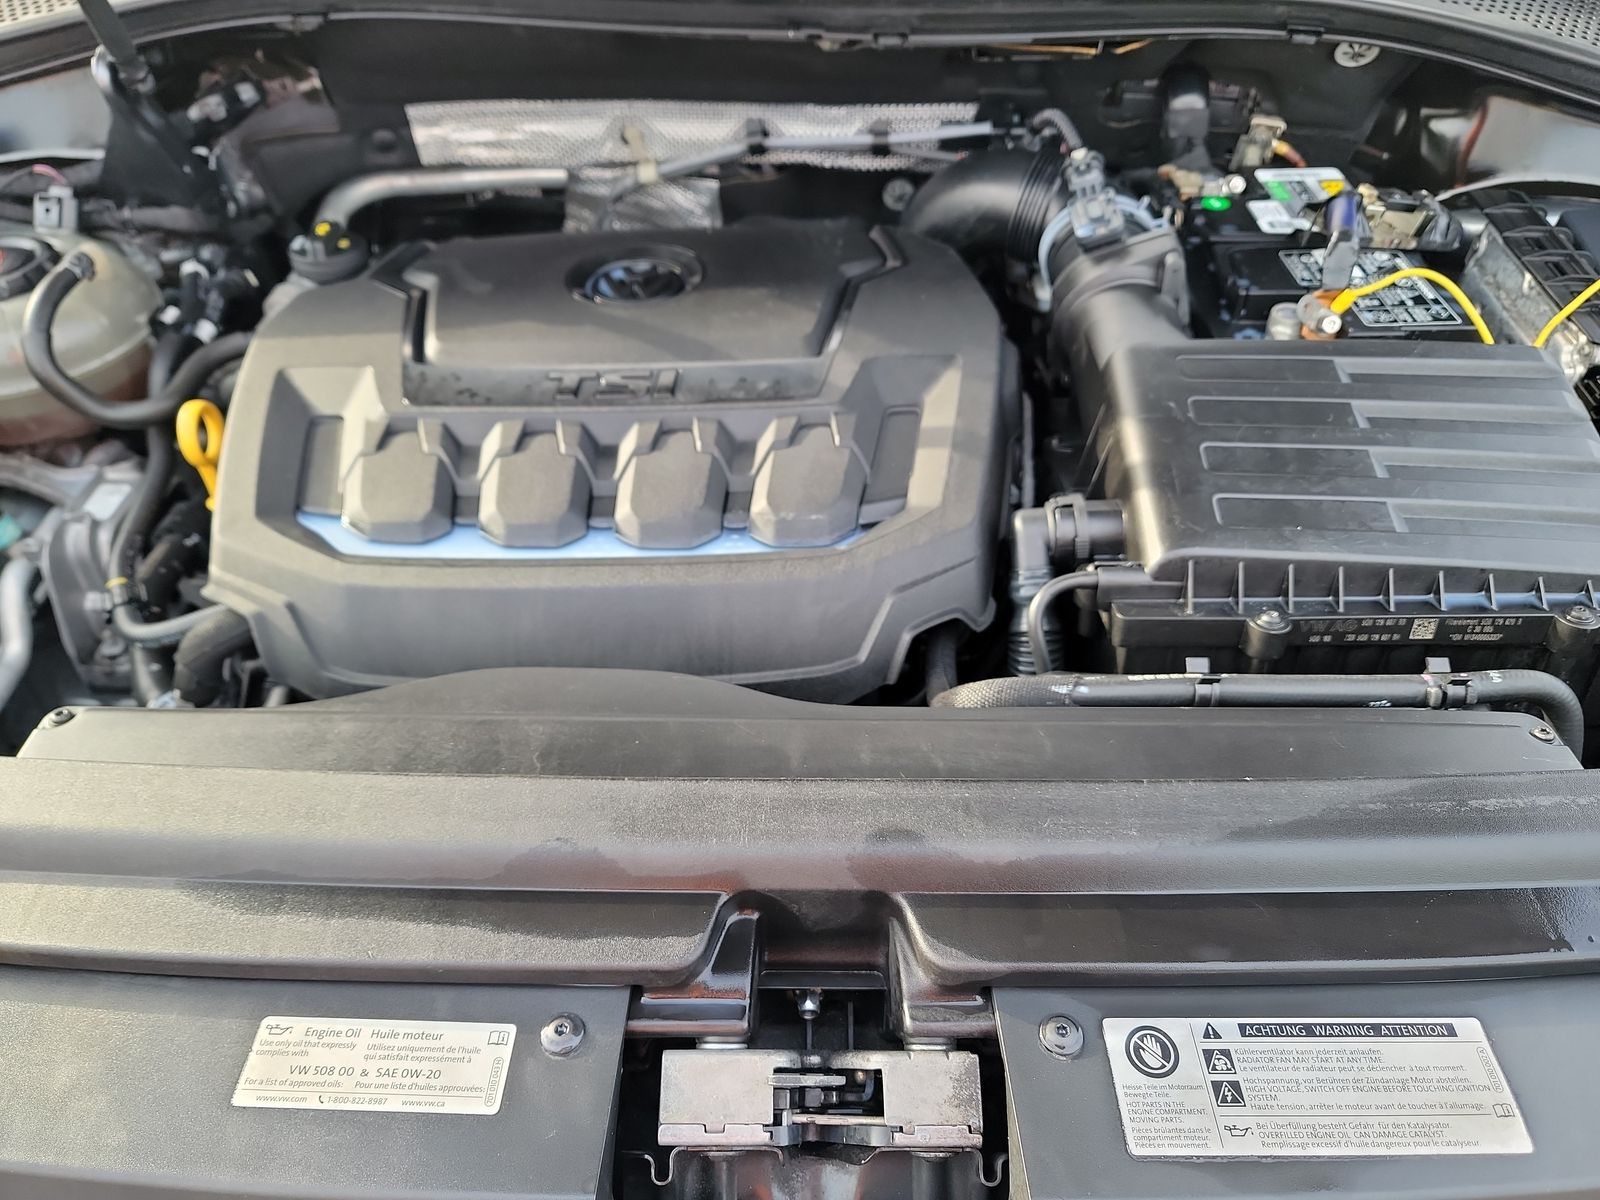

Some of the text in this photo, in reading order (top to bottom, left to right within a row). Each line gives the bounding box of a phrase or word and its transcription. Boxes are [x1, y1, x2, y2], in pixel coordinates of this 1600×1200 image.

[546, 369, 679, 400] TSI
[305, 1027, 361, 1040] Engine Oil
[370, 1029, 443, 1041] Huile moteur
[1246, 1025, 1448, 1036] ACHTUNG WARNING ATTENTION
[260, 1039, 274, 1047] Use
[275, 1040, 291, 1049] only
[321, 1042, 357, 1051] expressly
[367, 1043, 395, 1052] Utilisez
[397, 1044, 444, 1054] uniquement
[458, 1046, 481, 1054] l'huile
[256, 1049, 290, 1058] complies
[1234, 1048, 1294, 1056] Kühlerventilator
[1316, 1048, 1347, 1057] jederzeit
[363, 1053, 377, 1061] qui
[378, 1053, 409, 1061] satisfait
[410, 1054, 465, 1063] expressément
[289, 1065, 441, 1079] VW 508 00 & SAE 0W-20
[1338, 1065, 1355, 1073] peut
[244, 1077, 258, 1085] For
[288, 1080, 326, 1089] approved
[327, 1080, 344, 1088] oils:
[1365, 1077, 1410, 1085] Zündanlage
[354, 1081, 373, 1090] Pour
[390, 1082, 406, 1091] liste
[407, 1082, 437, 1091] d'huiles
[438, 1085, 486, 1094] approuvées:
[256, 1095, 308, 1103] www.vw.com
[327, 1096, 388, 1105] 1-800-822-8987
[401, 1099, 446, 1107] www.vw.ca
[1277, 1103, 1308, 1111] tension,
[1337, 1102, 1343, 1110] le
[1256, 1122, 1268, 1130] Bei
[1269, 1121, 1317, 1131] Überfüllung
[1378, 1121, 1389, 1129] für
[1391, 1121, 1406, 1129] den
[1407, 1121, 1452, 1130] Katalysator.
[1259, 1131, 1304, 1139] OVERFILLED
[1306, 1131, 1336, 1139] ENGINE
[1261, 1141, 1310, 1150] Remplissage
[1371, 1140, 1411, 1149] dangereux
[1413, 1141, 1430, 1149] pour
[1441, 1140, 1481, 1149] catalyseur.
